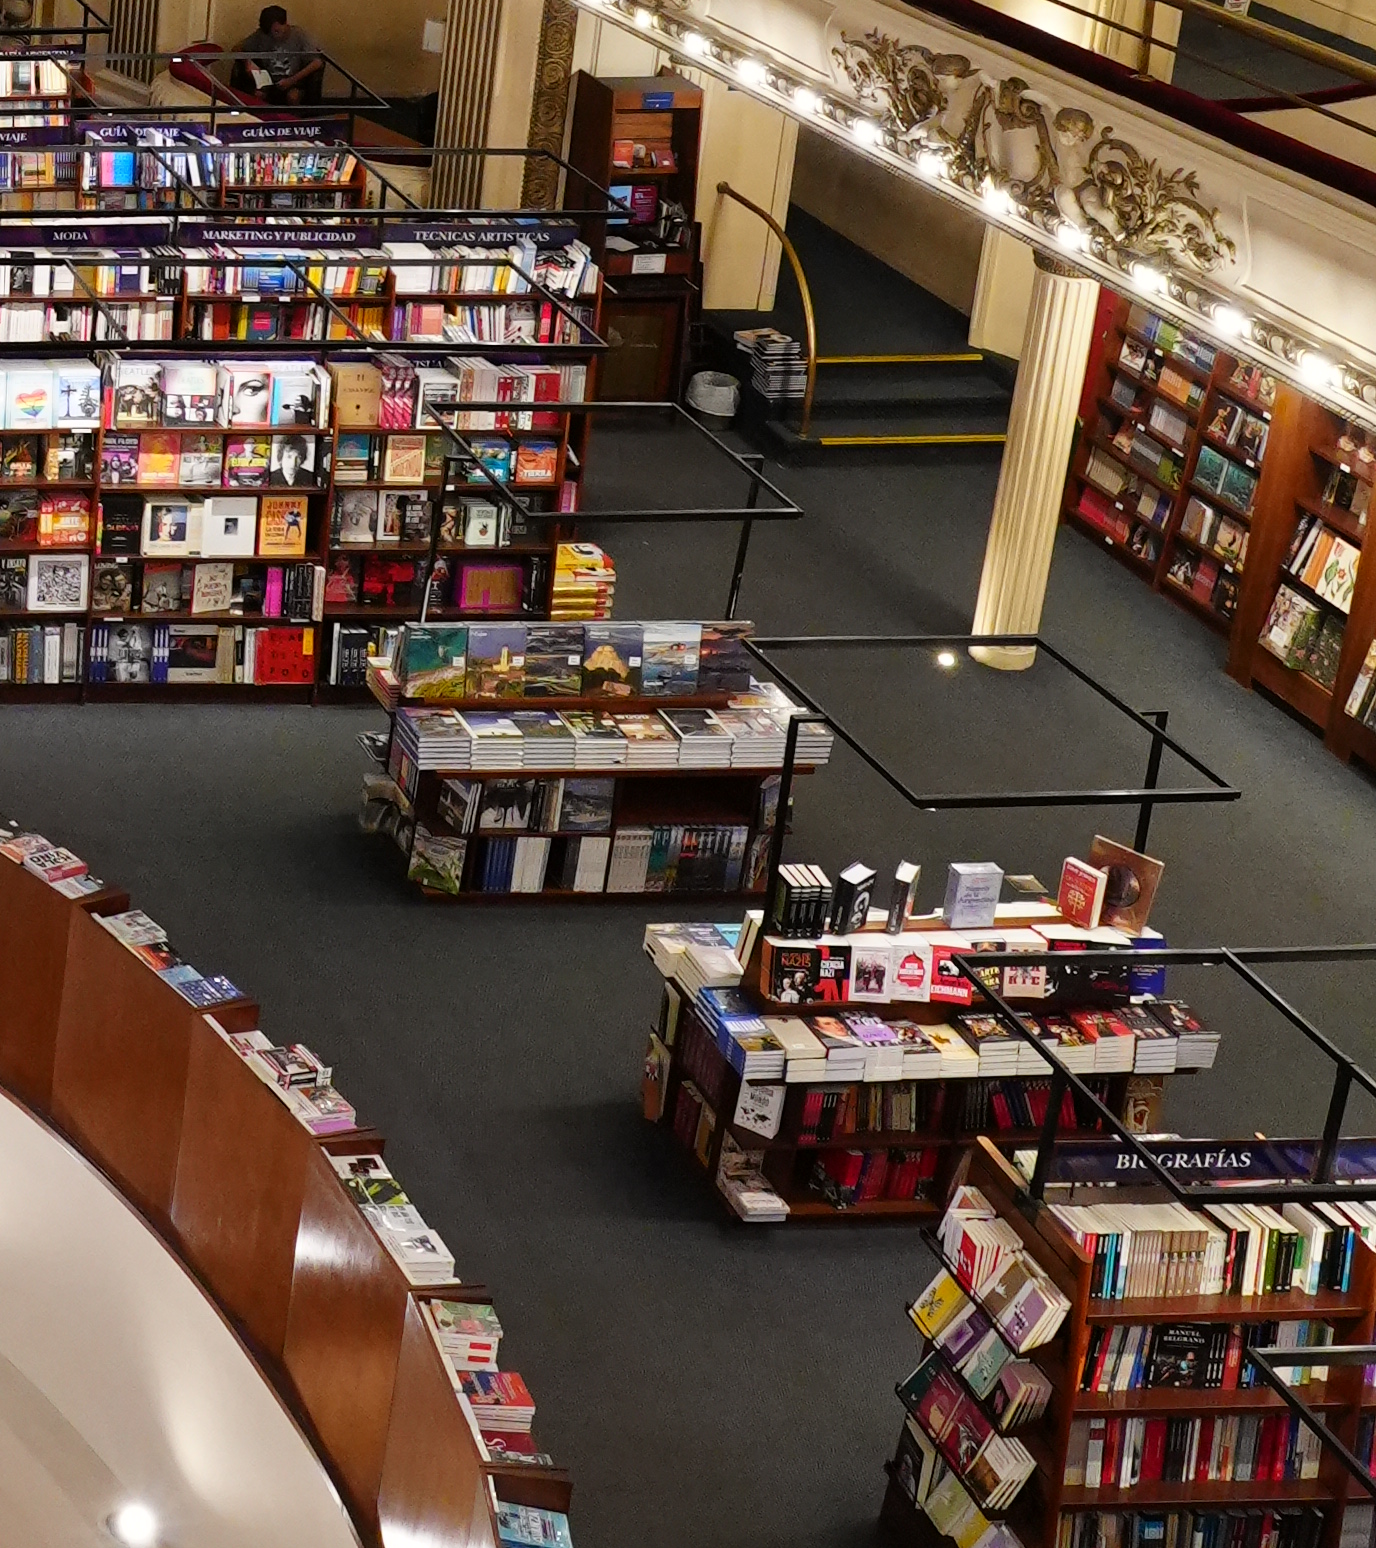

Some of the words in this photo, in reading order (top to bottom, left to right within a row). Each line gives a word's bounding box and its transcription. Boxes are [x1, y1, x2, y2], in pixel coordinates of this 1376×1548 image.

[242, 125, 273, 138] GUÍAS
[277, 128, 290, 137] DE
[293, 126, 322, 137] VIAJE
[53, 232, 88, 241] MODA
[203, 231, 272, 242] MARKETING
[284, 231, 356, 242] PUBLICIDAD
